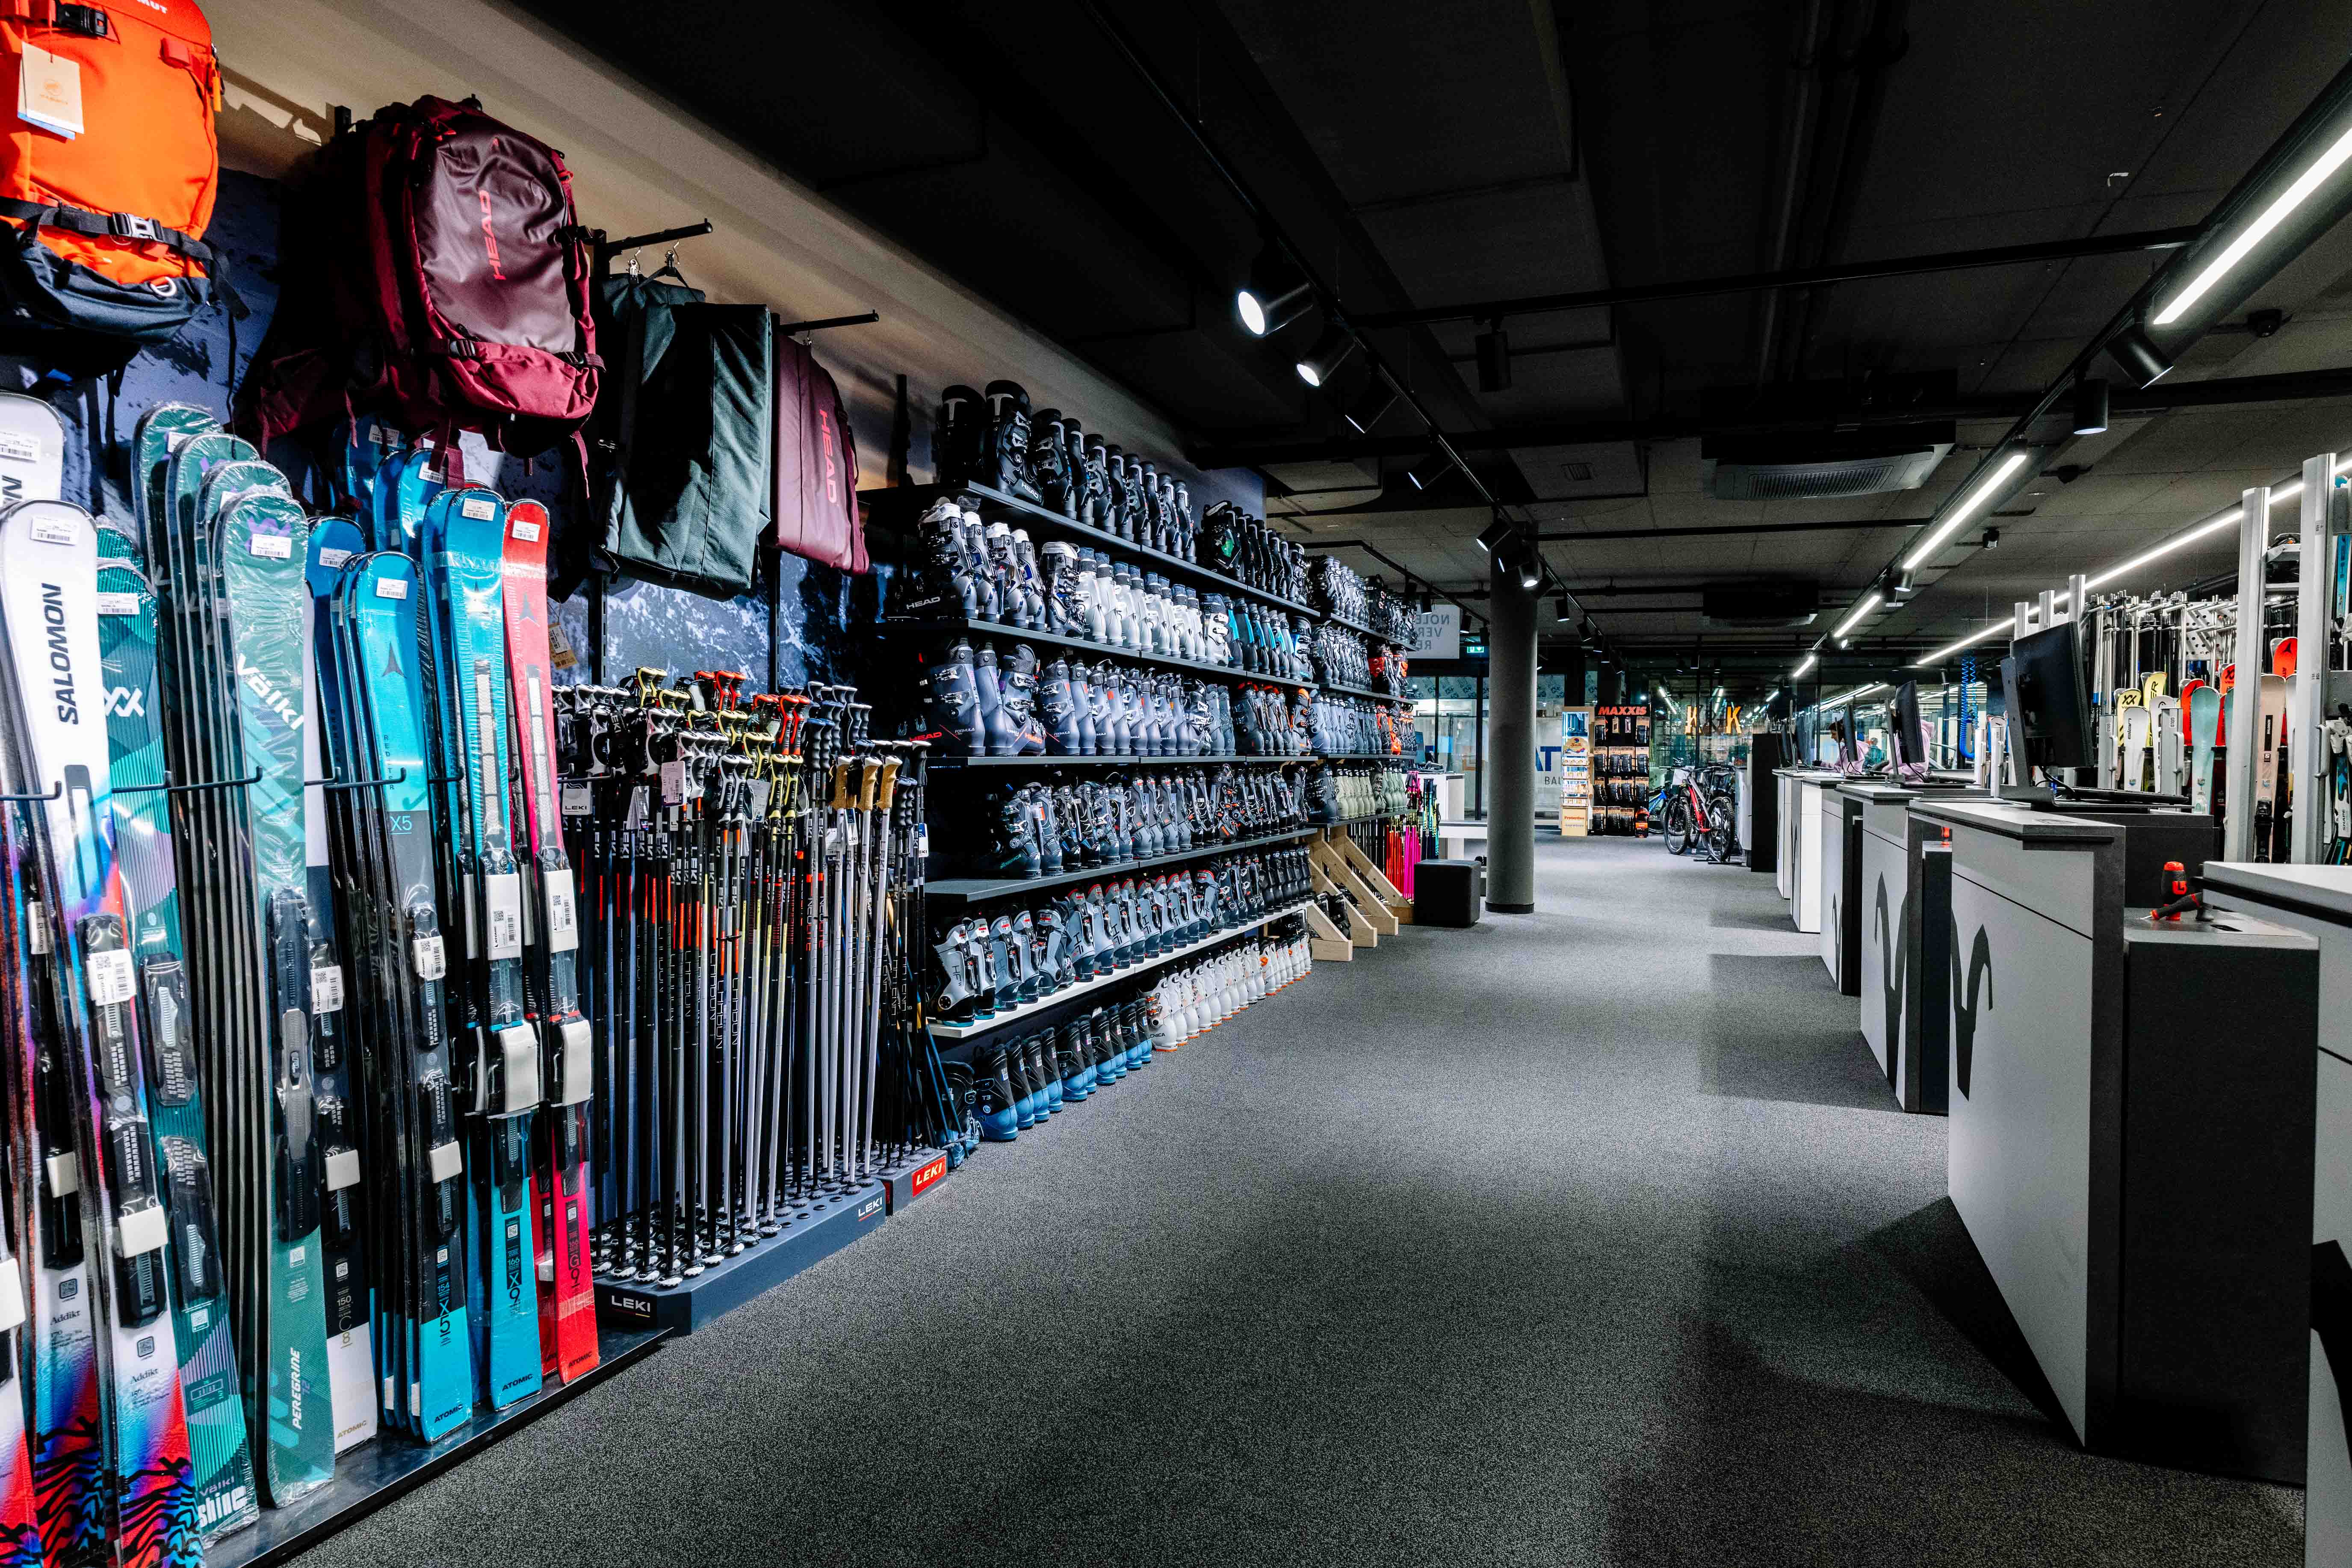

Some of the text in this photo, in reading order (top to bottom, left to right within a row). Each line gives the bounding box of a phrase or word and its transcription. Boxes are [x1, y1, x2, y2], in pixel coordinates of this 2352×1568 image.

[479, 189, 506, 281] HEAD
[819, 409, 837, 503] HEAD
[1021, 481, 1039, 499] HEAD
[906, 596, 941, 609] HEAD
[1067, 618, 1083, 633] HEAD
[41, 582, 79, 725] SALOMON
[1598, 706, 1647, 715] MAXXIS
[611, 715, 621, 733] EKI
[1726, 706, 1741, 734] K
[910, 731, 943, 742] HEAD
[390, 815, 413, 831] X5
[916, 1163, 943, 1187] LEKI
[858, 1197, 883, 1217] LEKI
[508, 1257, 520, 1267] 166
[437, 1282, 450, 1293] 154
[337, 1295, 352, 1306] 150
[611, 1295, 651, 1312] LEKI
[50, 1310, 81, 1325] Addikt
[568, 1352, 593, 1368] ATOMIC
[130, 1368, 159, 1385] Addikt
[502, 1373, 533, 1391] ATOMIC
[290, 1347, 302, 1430] PEREGRINE
[434, 1403, 464, 1424] ATOMIC
[337, 1420, 368, 1438] ATOMIC
[198, 1485, 247, 1528] shine
